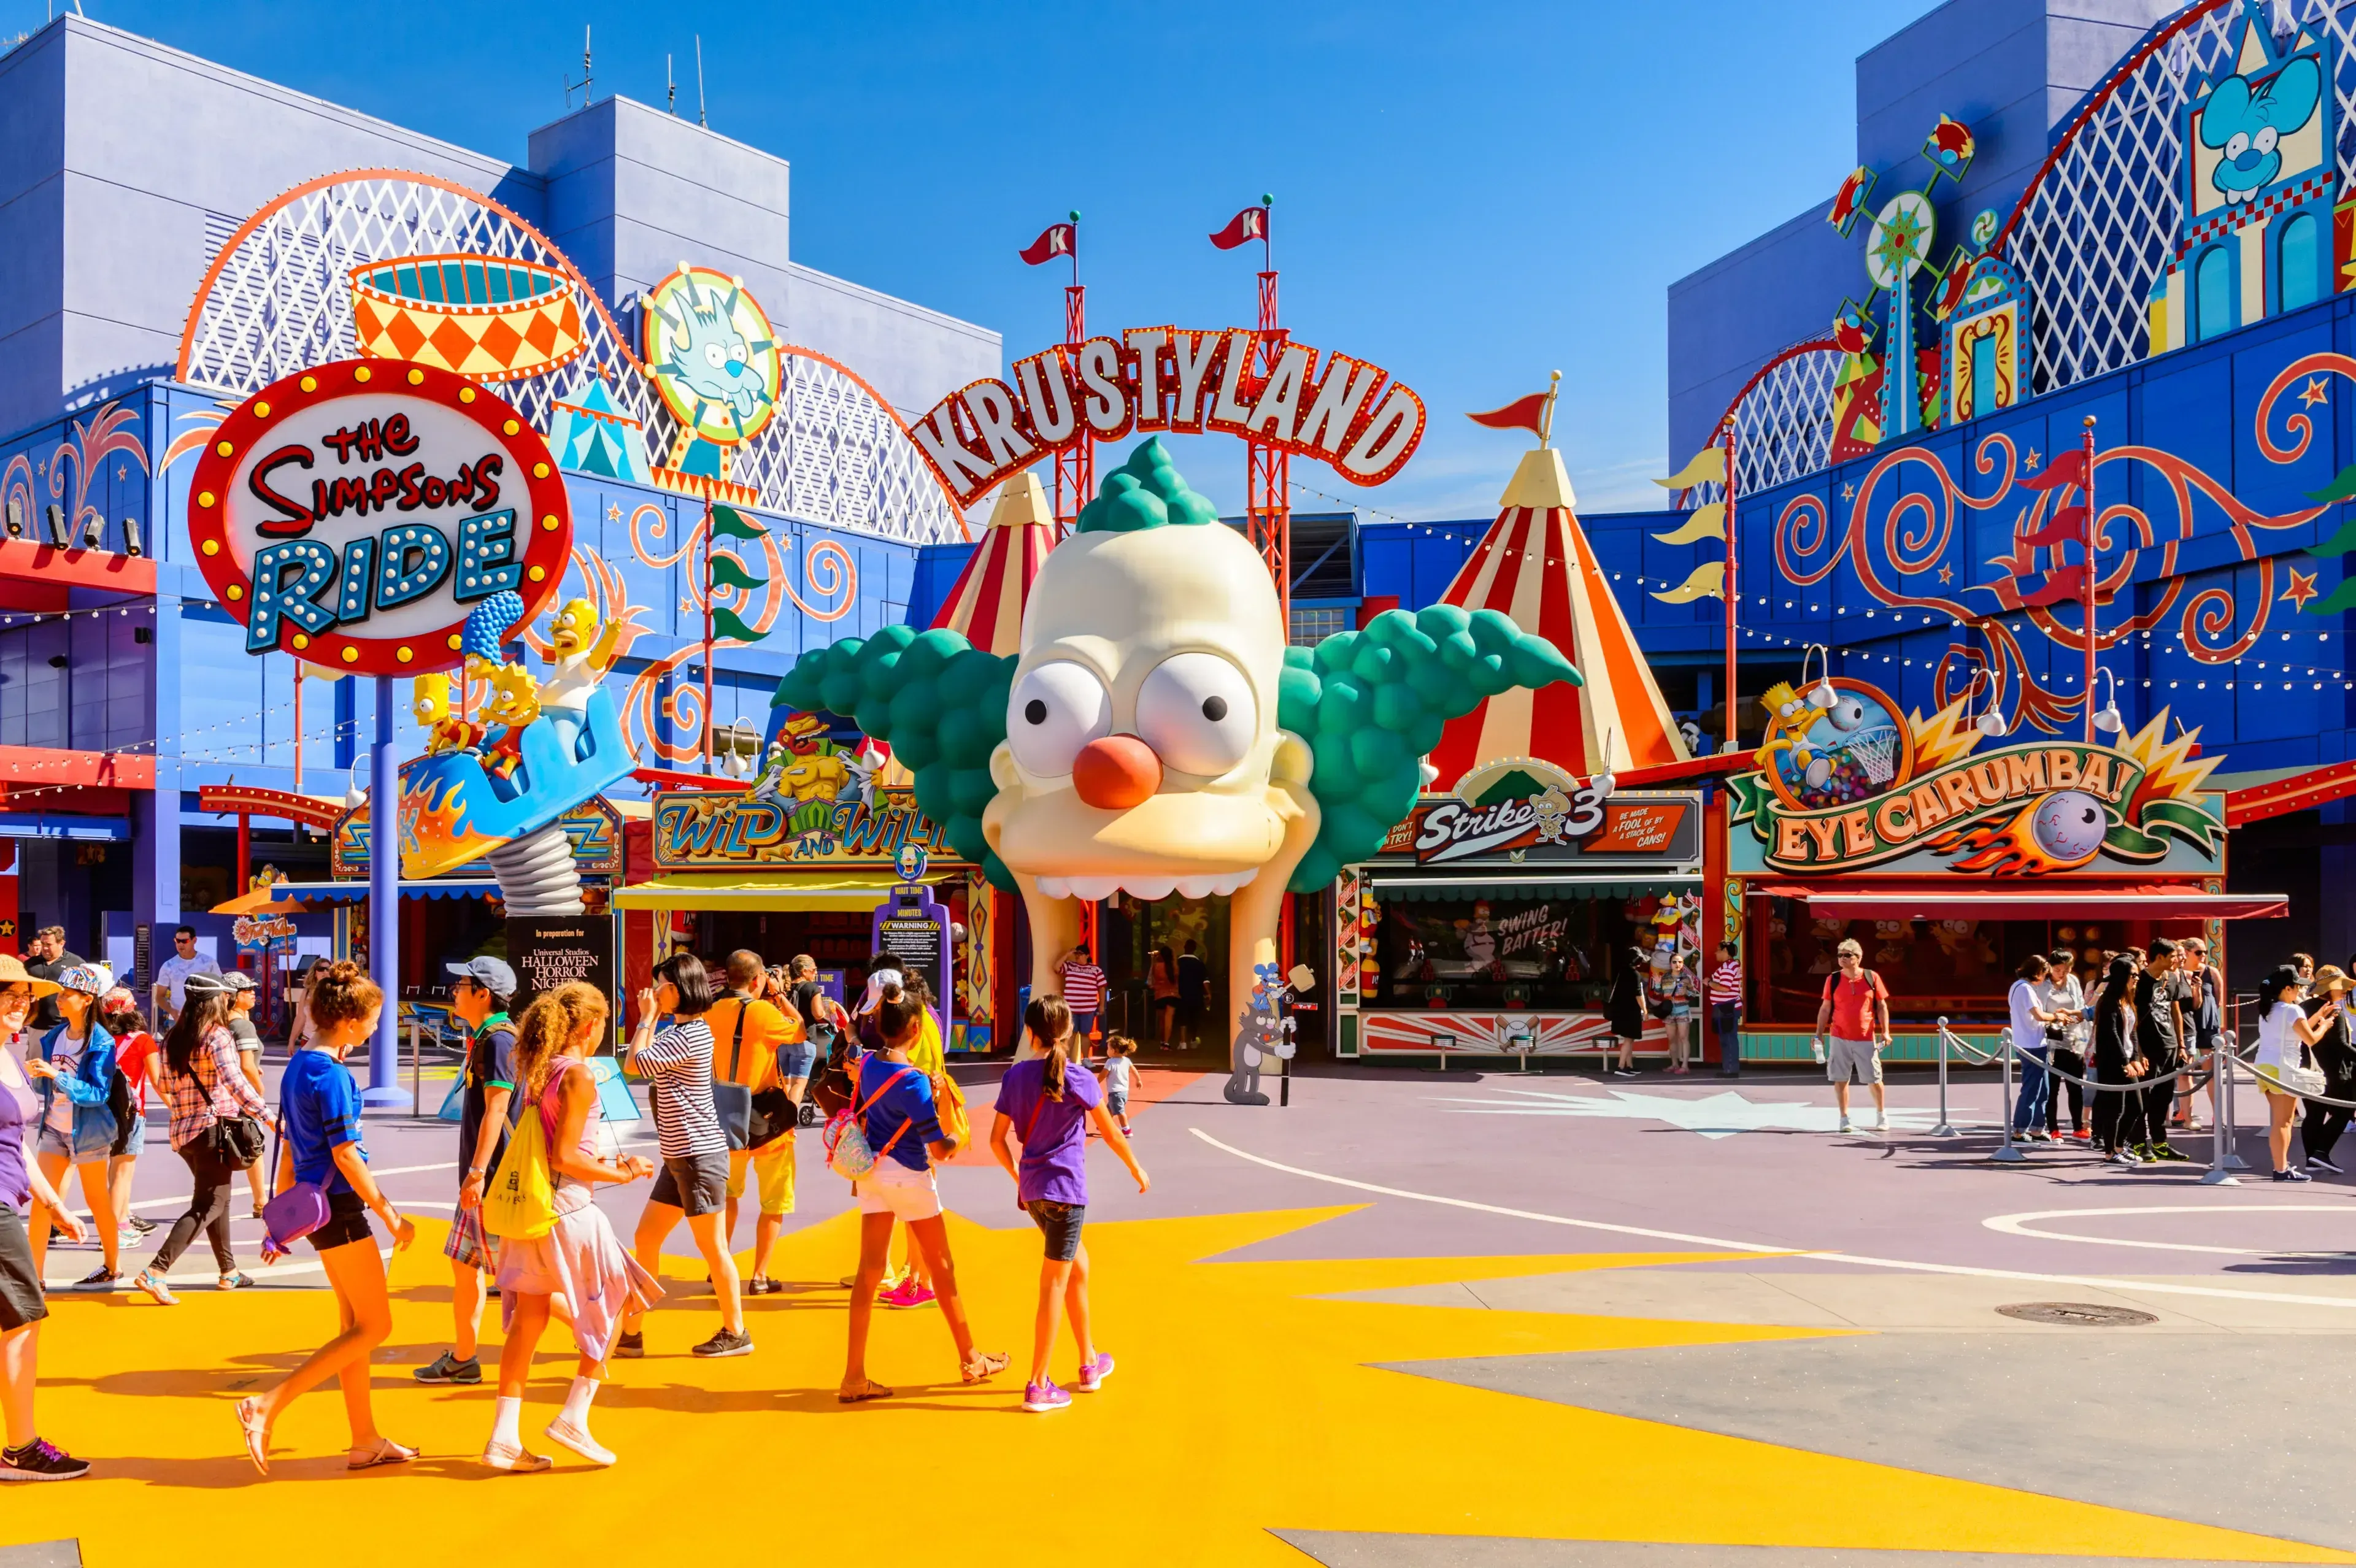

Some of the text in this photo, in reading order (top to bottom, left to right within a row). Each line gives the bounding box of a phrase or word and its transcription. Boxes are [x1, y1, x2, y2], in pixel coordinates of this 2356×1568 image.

[1242, 210, 1261, 237] K
[1050, 226, 1069, 254] K
[907, 325, 1425, 508] KRUSTYLAND
[245, 508, 525, 656] RIDE
[1774, 748, 2138, 862] EYE CARUMBA!
[1415, 788, 1603, 850] Strike 3
[1620, 808, 1649, 820] BE MADE
[795, 833, 834, 859] AND
[831, 801, 953, 855] WILLI
[1393, 821, 1413, 834] DON'T
[1619, 818, 1642, 832] FOOL
[1390, 831, 1412, 845] TRY!
[1626, 828, 1646, 839] STACK
[1637, 832, 1666, 848] CANS!
[898, 909, 922, 917] MINUTES
[1498, 904, 1549, 936] SWING
[543, 929, 574, 939] preparation
[1502, 917, 1568, 956] BATTER!
[522, 956, 599, 967] HALLOWEEN
[535, 966, 588, 978] HORROR
[531, 977, 578, 990] NIGH
